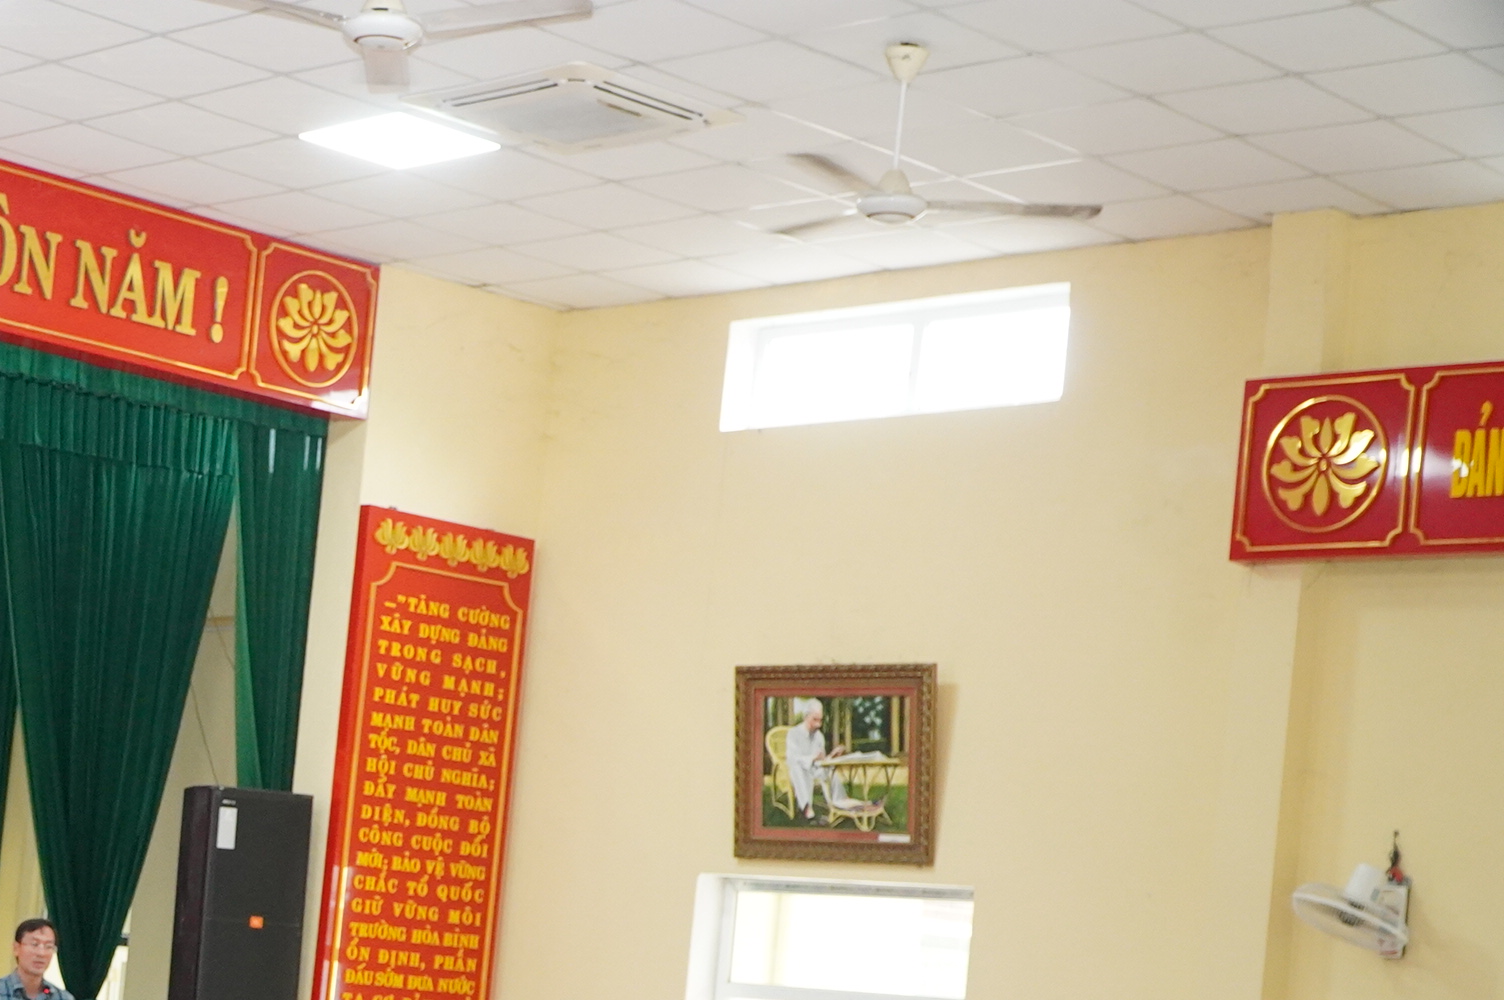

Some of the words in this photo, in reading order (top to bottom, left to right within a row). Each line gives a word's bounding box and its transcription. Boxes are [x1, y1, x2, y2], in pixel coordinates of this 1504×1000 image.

[73, 228, 202, 342] NĂM
[458, 605, 510, 630] CƯỜNG
[378, 639, 441, 664] TRONG
[468, 629, 507, 652] ĐẢNG
[376, 662, 430, 685] VỮNG
[374, 686, 420, 708] PHÁT
[428, 697, 462, 715] HUY
[469, 700, 502, 721] SỨC
[422, 716, 464, 738] TOÀN
[407, 737, 436, 757] DÂN
[442, 742, 472, 763] CHỦ
[366, 755, 396, 776] HỘI
[403, 760, 434, 780] CHỦ
[405, 786, 447, 807] MẠNH
[359, 824, 403, 846] CÔNG
[411, 833, 453, 855] CUỘC
